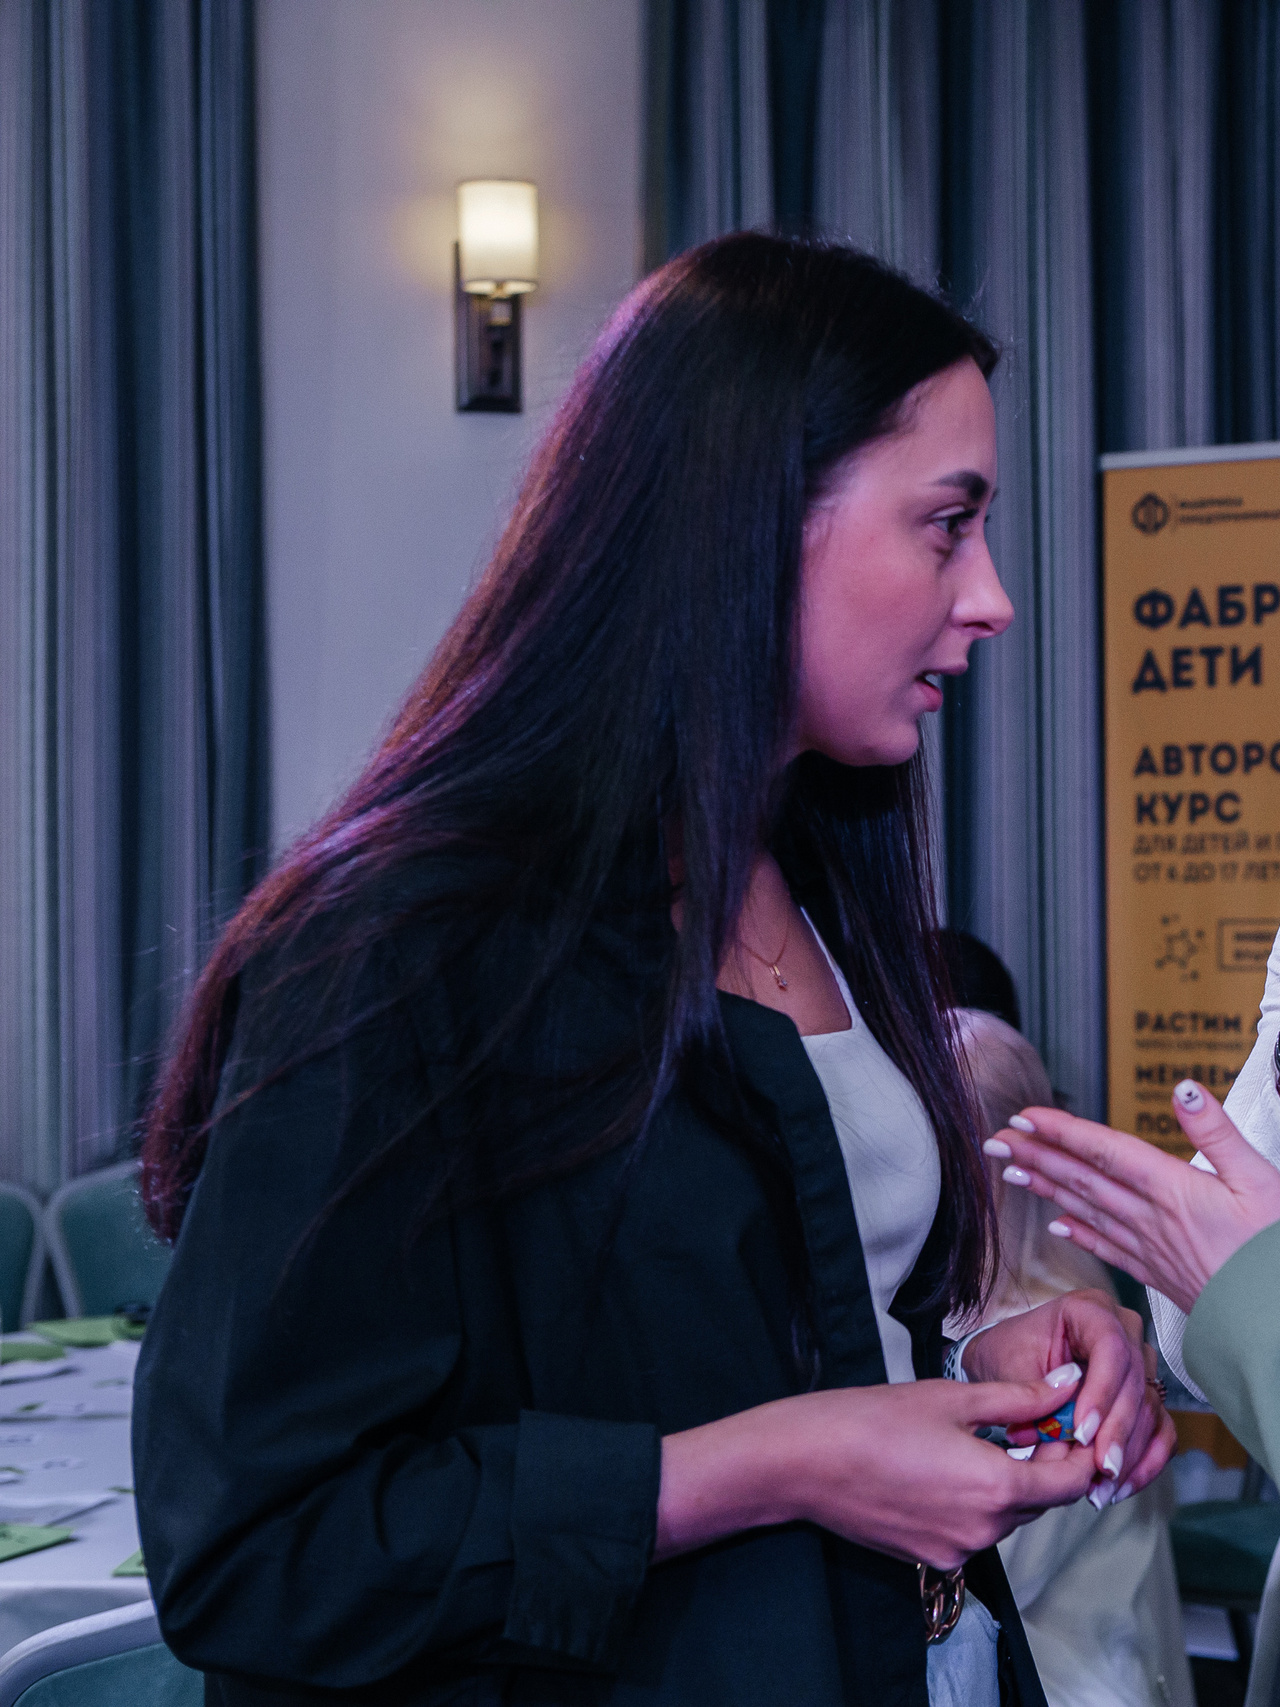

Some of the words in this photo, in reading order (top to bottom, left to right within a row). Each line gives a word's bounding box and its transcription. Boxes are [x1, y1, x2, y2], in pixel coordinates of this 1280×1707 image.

[1132, 645, 1262, 694] ДЕТИ
[1134, 792, 1242, 825] КУРС
[1182, 831, 1249, 854] ДЕТЕЙ
[1133, 862, 1161, 883] ОТ
[1183, 862, 1216, 884] ДО
[1135, 1010, 1242, 1033] РАСТИМ
